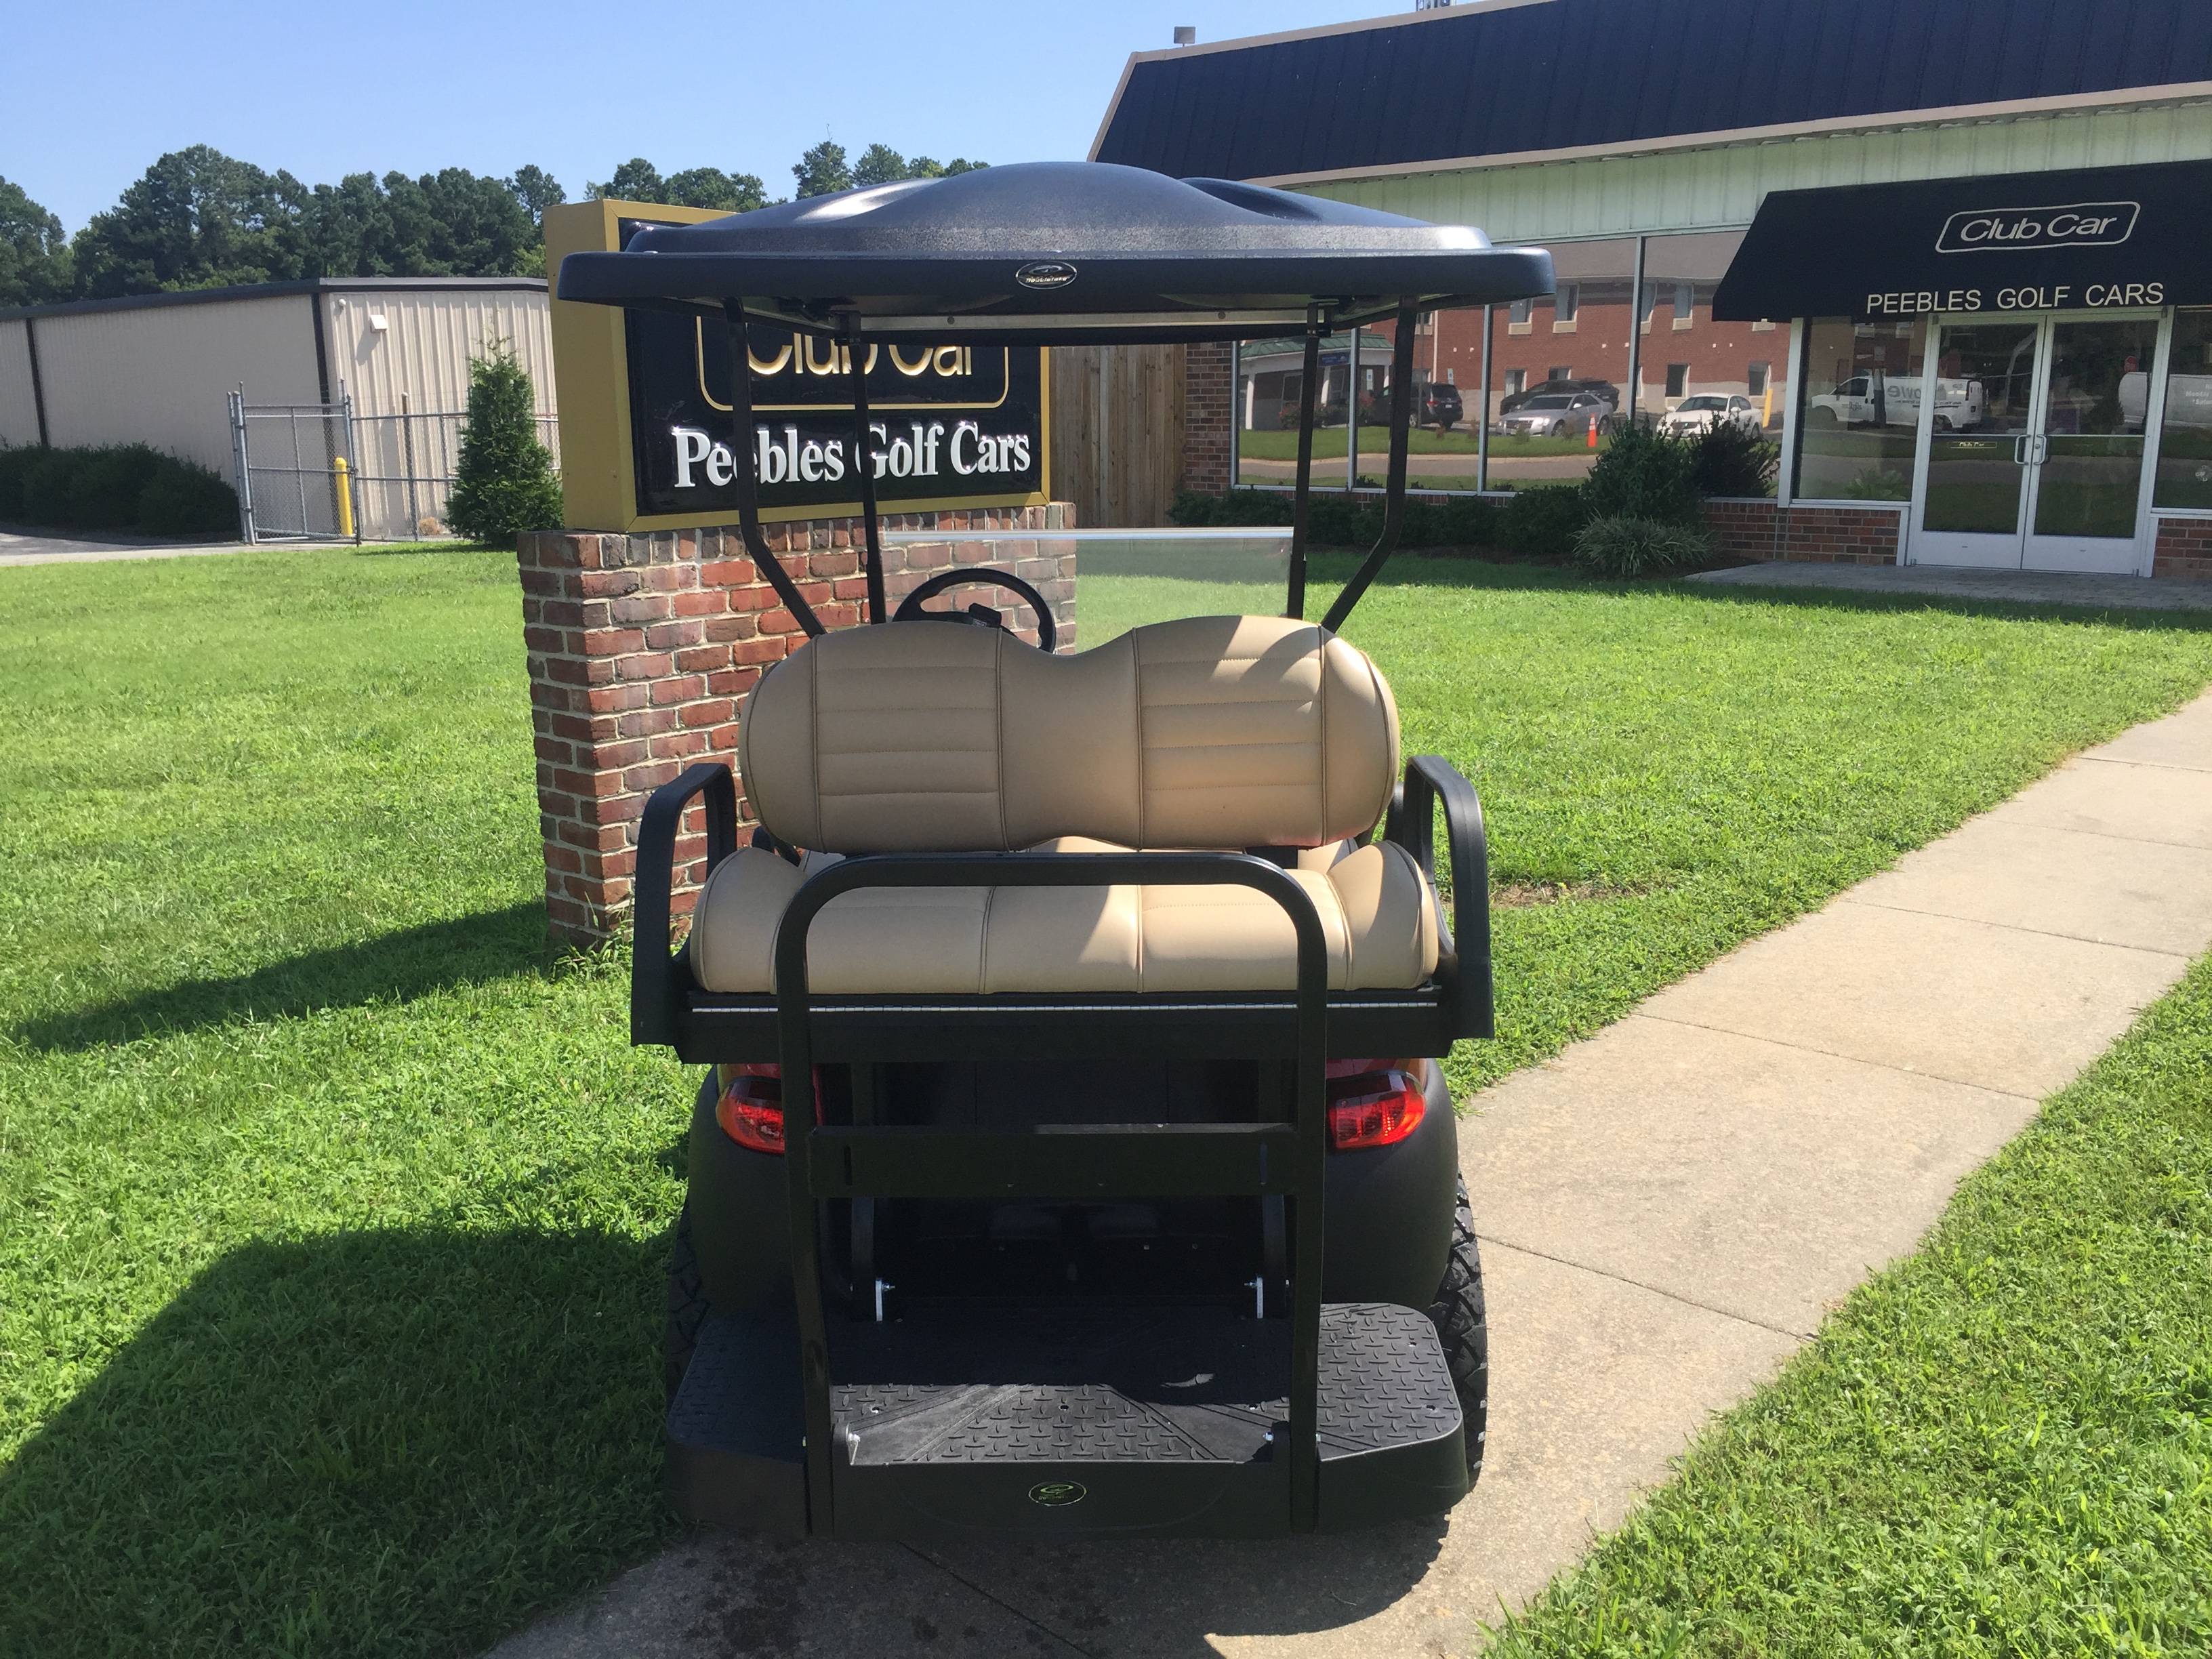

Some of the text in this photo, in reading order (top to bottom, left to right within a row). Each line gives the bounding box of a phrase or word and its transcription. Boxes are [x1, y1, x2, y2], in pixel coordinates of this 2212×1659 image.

[1961, 213, 2118, 241] Club Car
[1866, 282, 2164, 314] PEEBLES GOLF CARS
[672, 421, 1031, 488] Pebles Golf Cars
